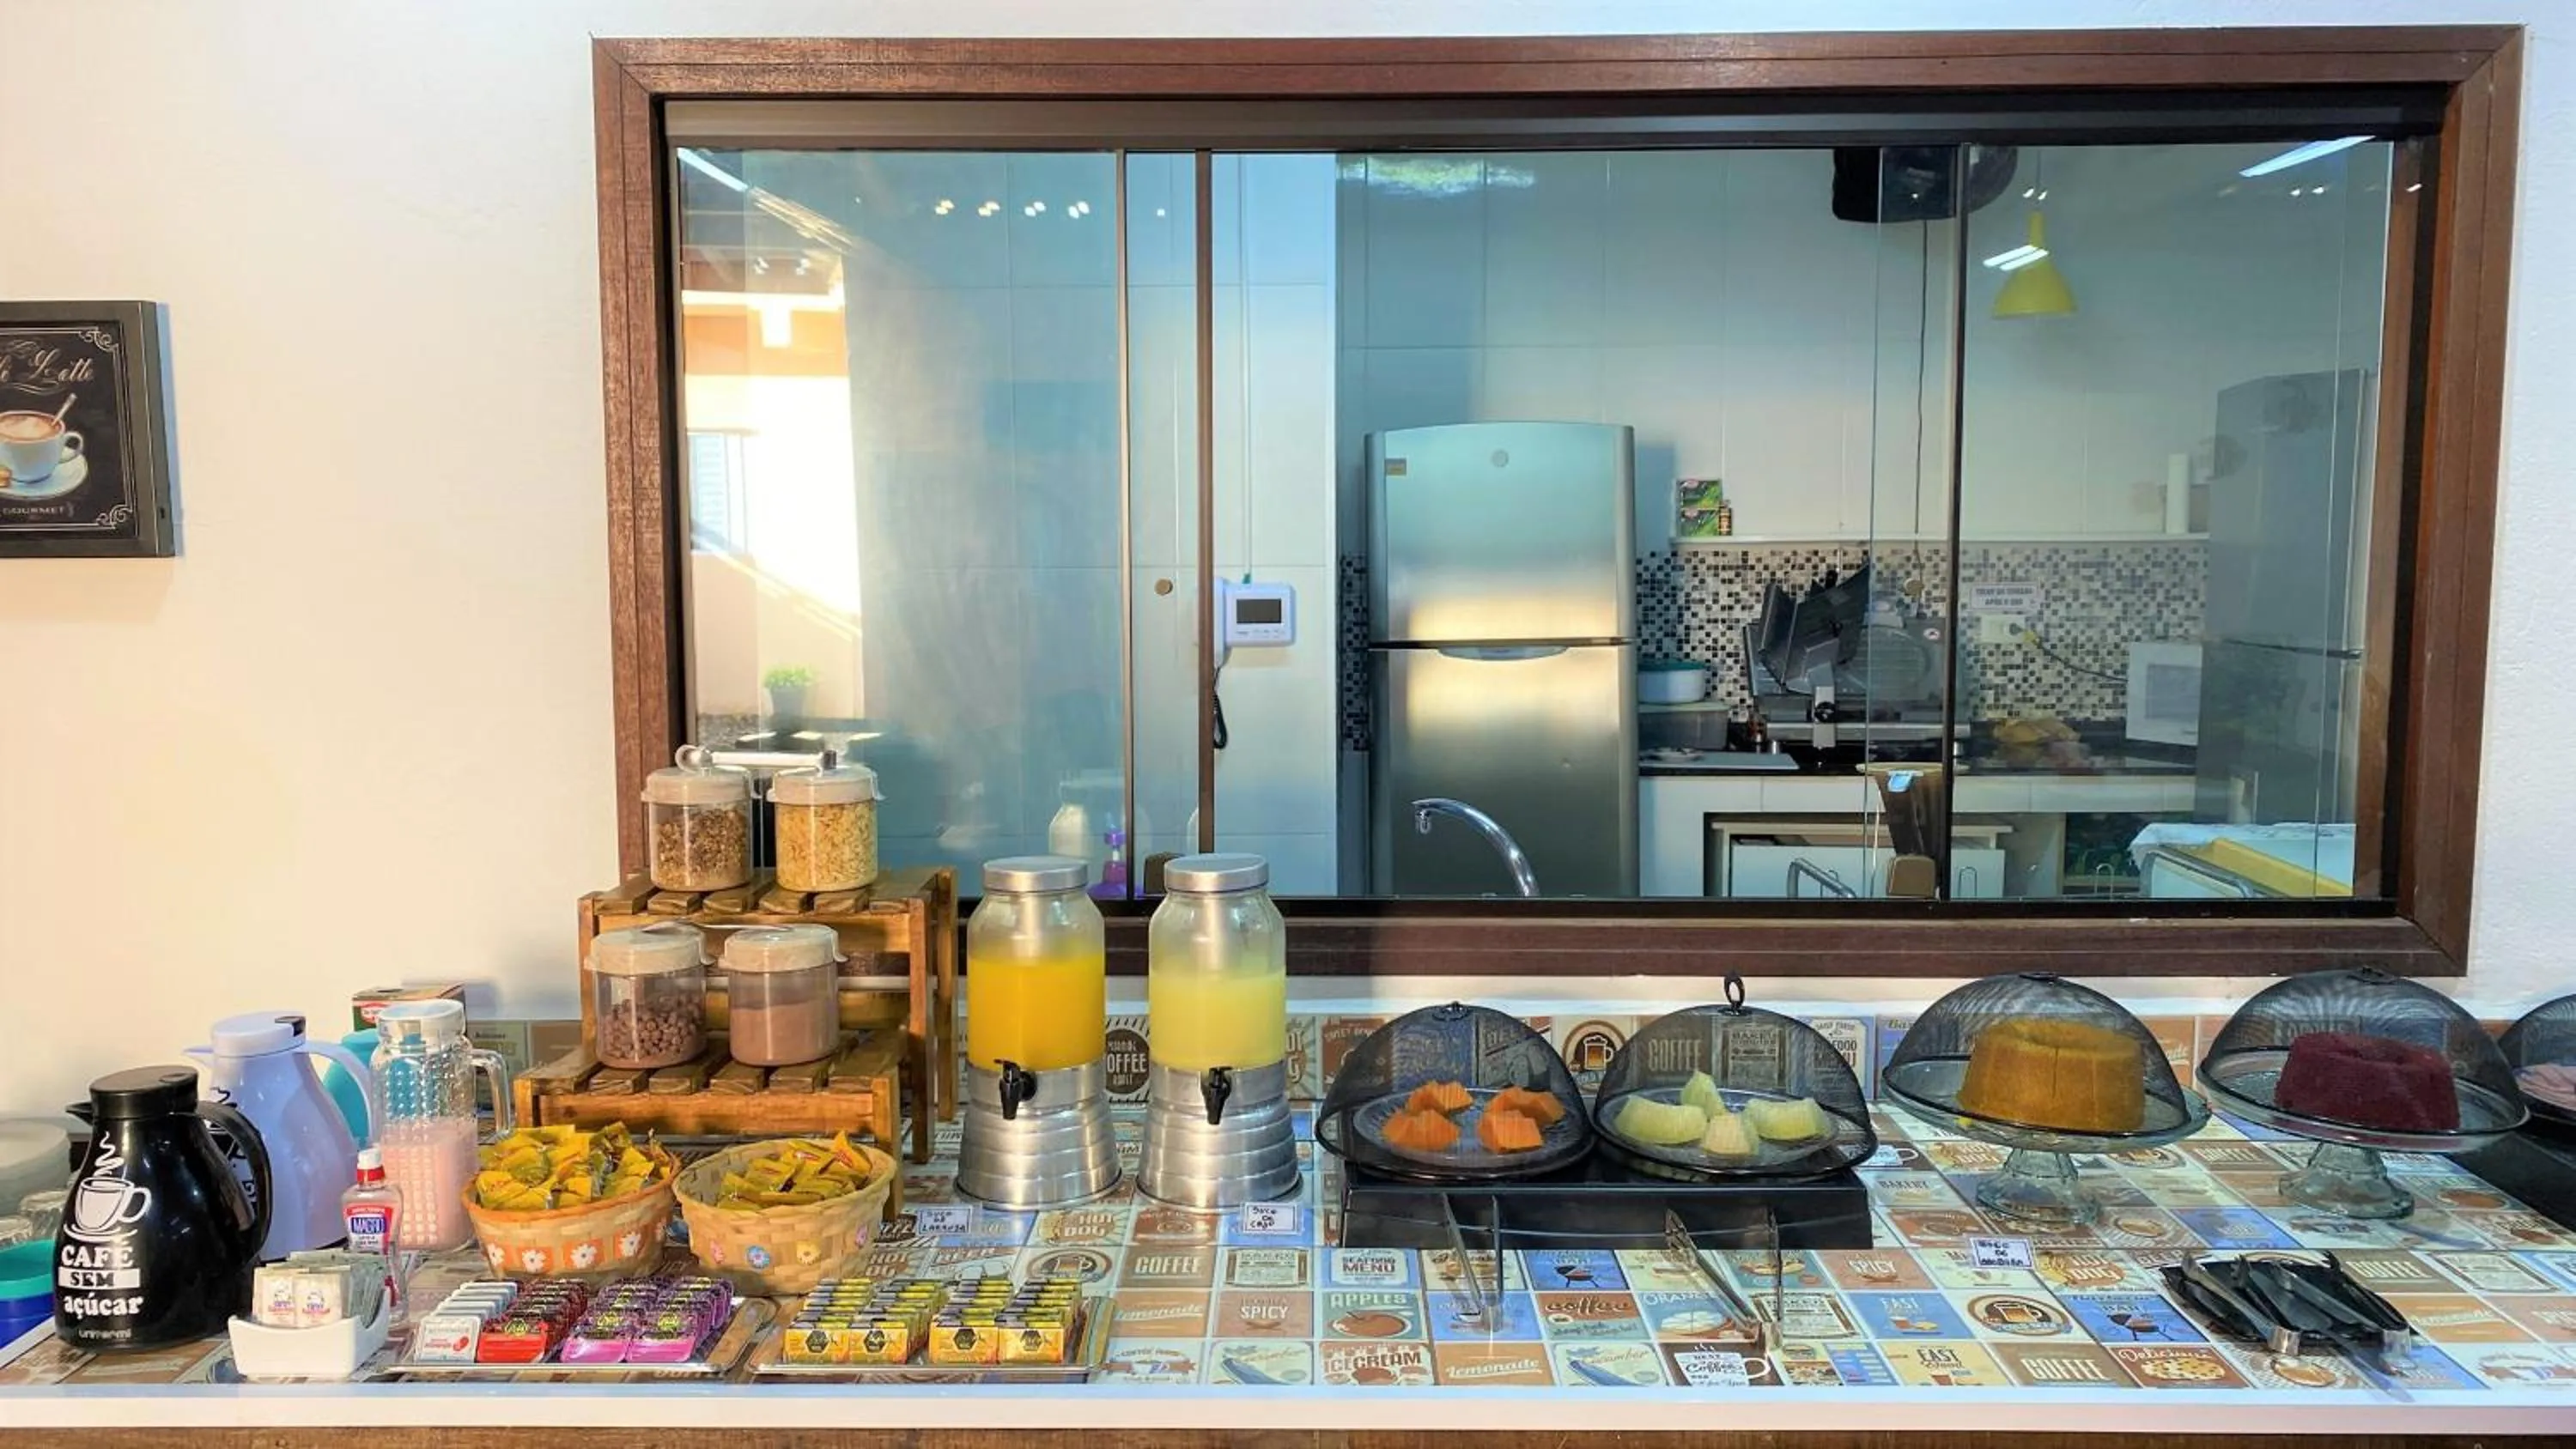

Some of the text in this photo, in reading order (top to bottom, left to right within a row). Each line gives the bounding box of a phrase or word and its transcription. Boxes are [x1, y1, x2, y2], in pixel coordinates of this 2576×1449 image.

[1106, 1052, 1148, 1074] OFFEE
[61, 1240, 134, 1268] CAFÉ
[1134, 1256, 1203, 1275] COFFEE
[1343, 1263, 1395, 1273] MENU
[70, 1271, 114, 1287] SEM
[64, 1292, 144, 1319] açúcar
[1332, 1293, 1407, 1308] APPLES
[1240, 1306, 1289, 1320] SPICY
[1323, 1352, 1422, 1373] ICE CREAM
[2020, 1358, 2112, 1381] COFFEE
